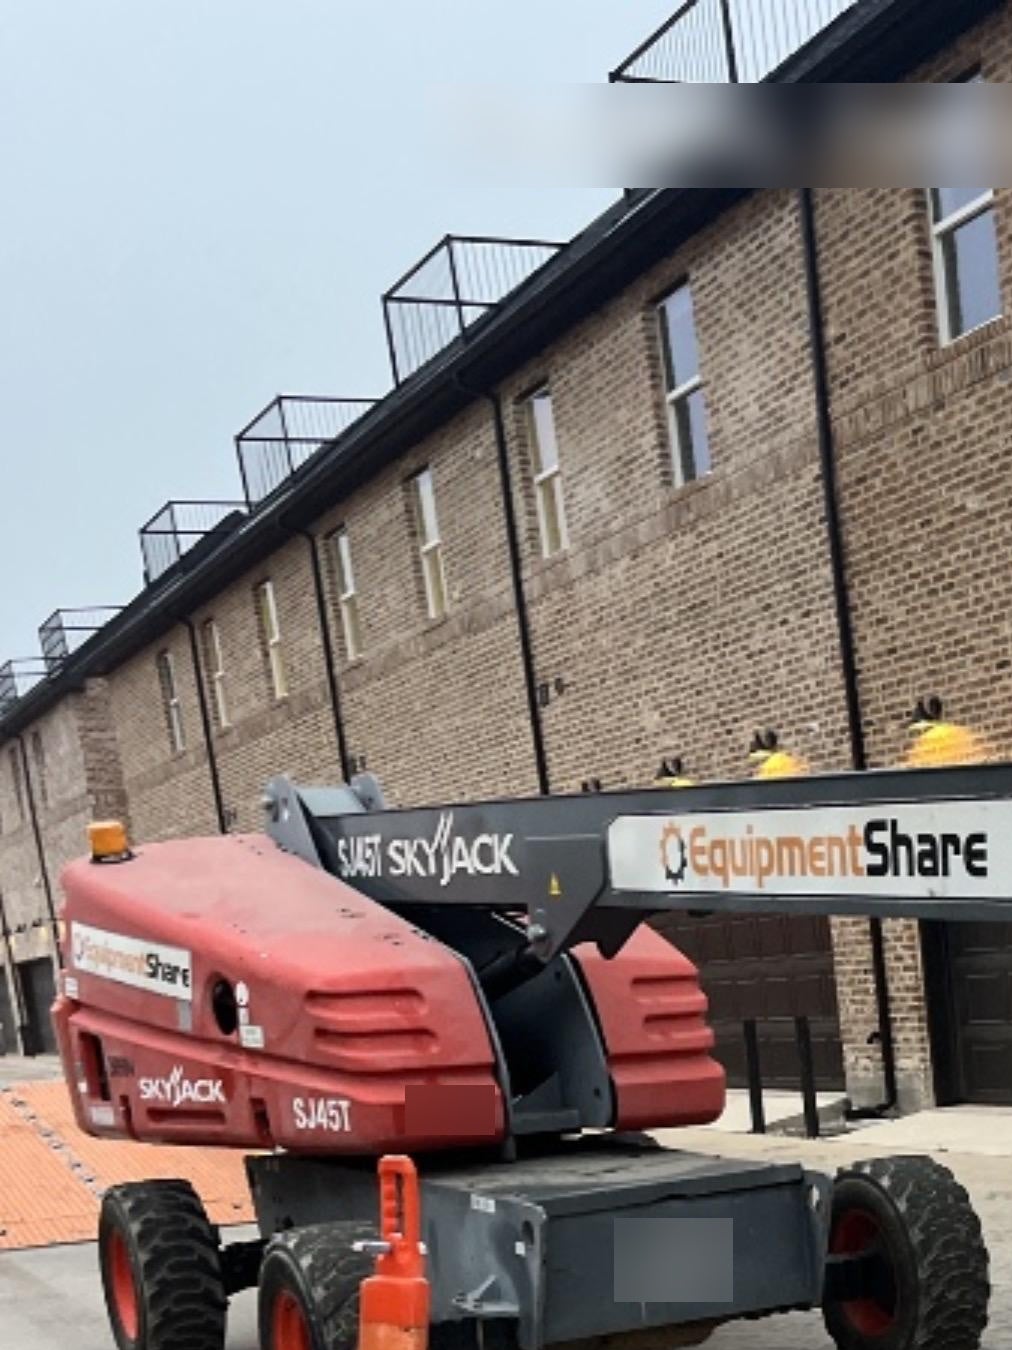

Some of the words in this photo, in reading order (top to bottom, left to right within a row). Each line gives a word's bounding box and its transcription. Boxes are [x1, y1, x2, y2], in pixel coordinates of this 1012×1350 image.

[387, 810, 519, 887] SKYJACK
[689, 818, 988, 888] EquipmentShare
[138, 1064, 226, 1107] SKYJACK
[292, 1097, 352, 1132] SJ45T
